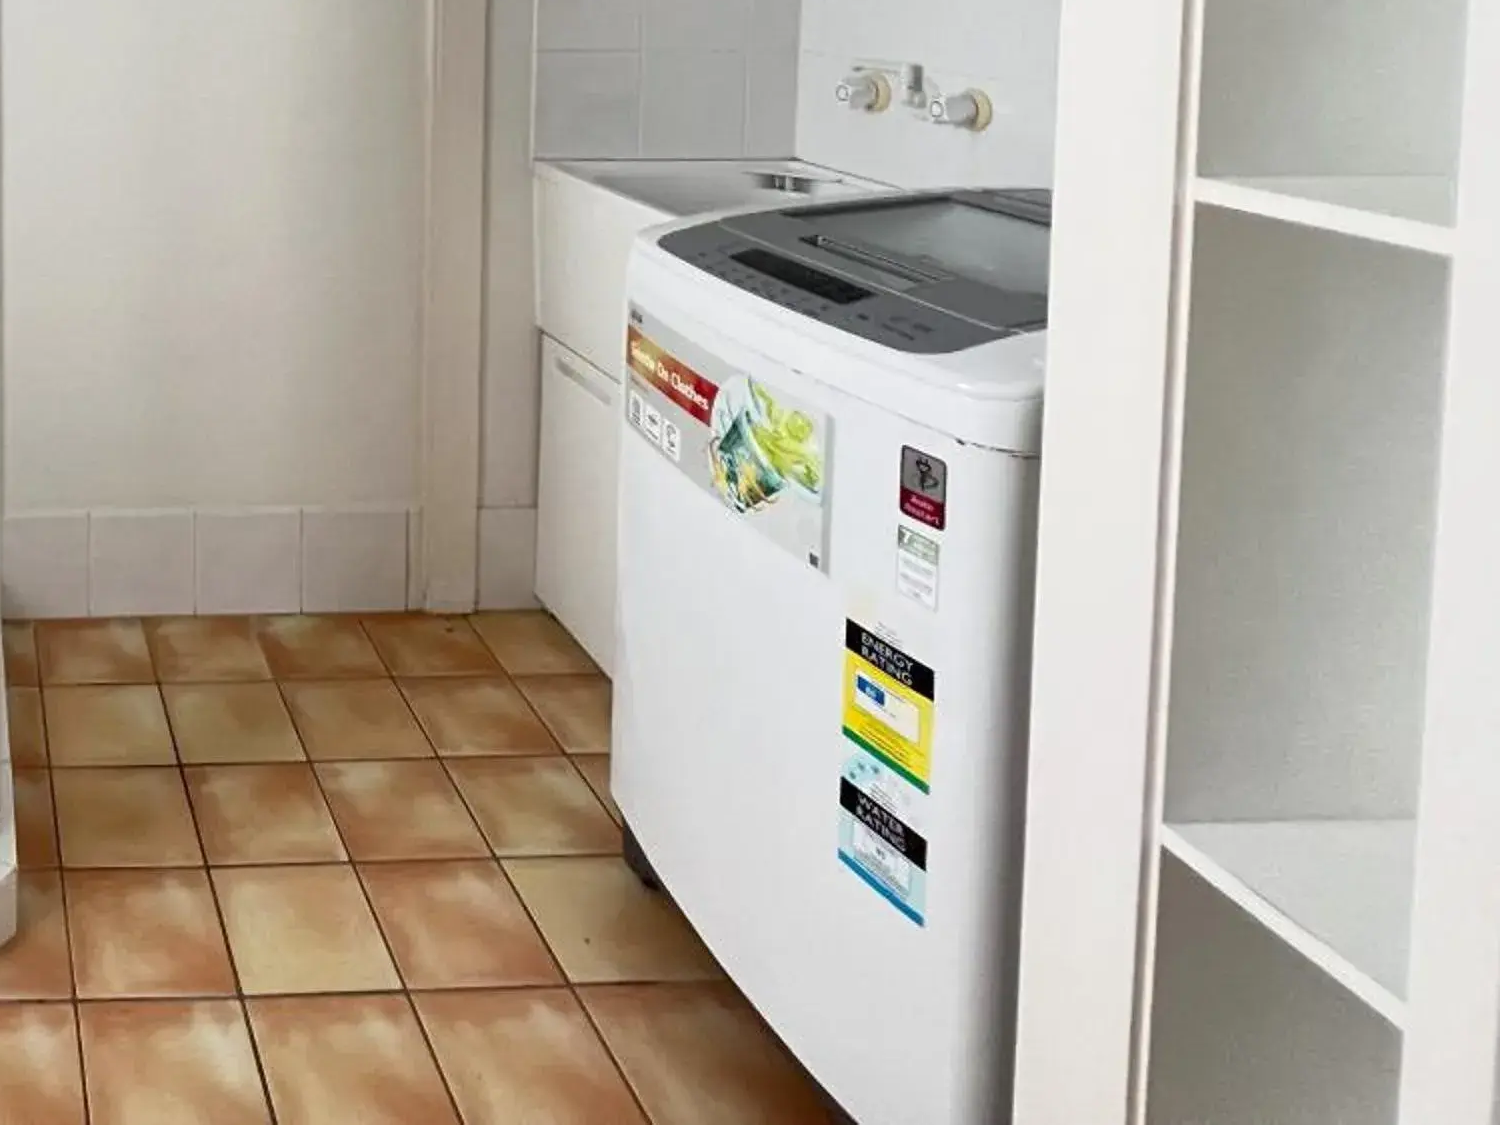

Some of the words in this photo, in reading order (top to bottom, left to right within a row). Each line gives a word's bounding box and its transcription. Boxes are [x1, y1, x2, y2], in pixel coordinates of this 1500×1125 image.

[671, 372, 709, 411] Clothes
[861, 632, 914, 670] ENERGY
[861, 645, 913, 686] RATING
[856, 805, 907, 852] RATING
[857, 791, 904, 837] WATER
